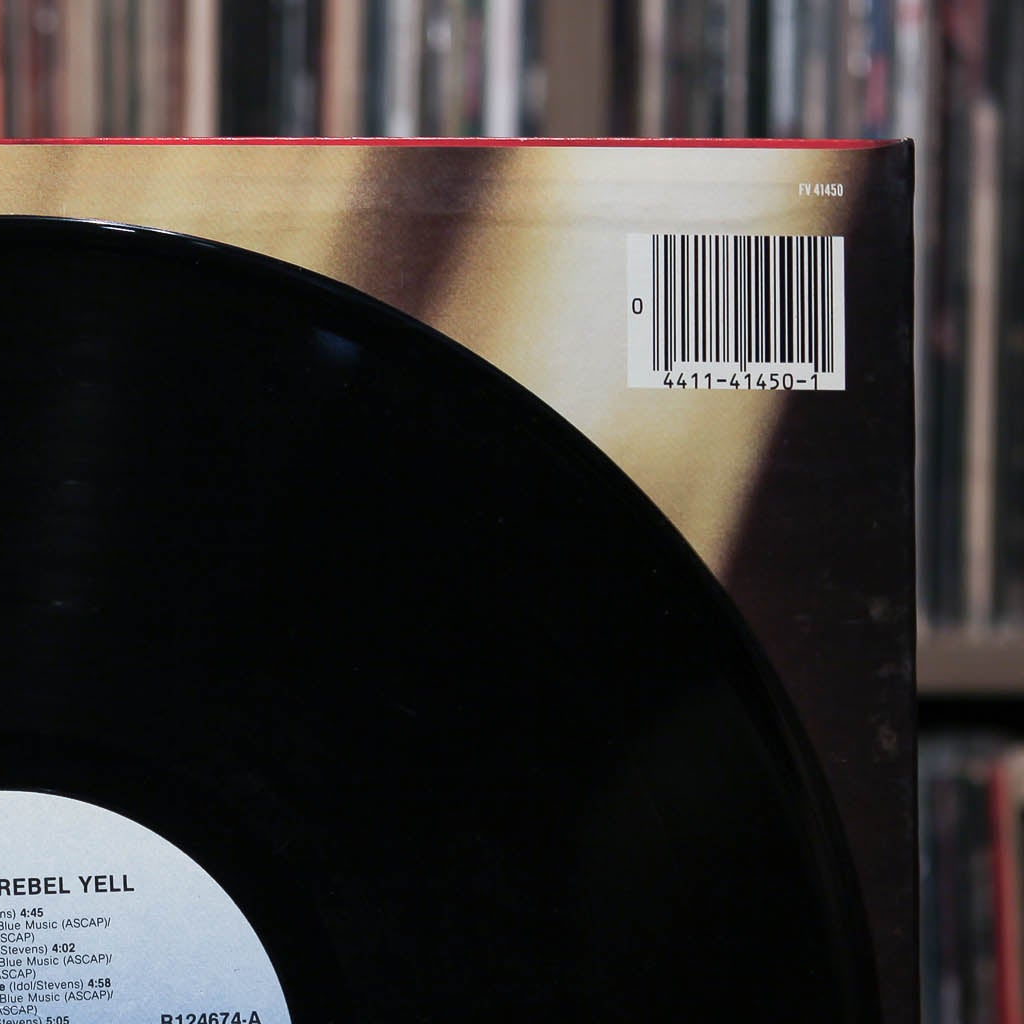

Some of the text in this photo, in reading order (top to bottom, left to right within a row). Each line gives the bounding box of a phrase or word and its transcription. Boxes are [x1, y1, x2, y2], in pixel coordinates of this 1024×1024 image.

[799, 184, 843, 197] FV 41450
[663, 372, 819, 390] 4411-41450-1
[78, 874, 135, 893] YELL
[20, 907, 44, 918] 4:45
[25, 919, 58, 930] Music
[62, 917, 111, 930] (ASCAP)/
[51, 943, 76, 953] 4:02
[26, 955, 59, 966] Music
[63, 953, 112, 966] (ASCAP)/
[9, 979, 84, 992] (Idol/Stevens)
[87, 978, 112, 988] 4:58
[0, 993, 24, 1004] Blue
[28, 992, 60, 1003] Music
[64, 990, 114, 1003] (ASCAP)/
